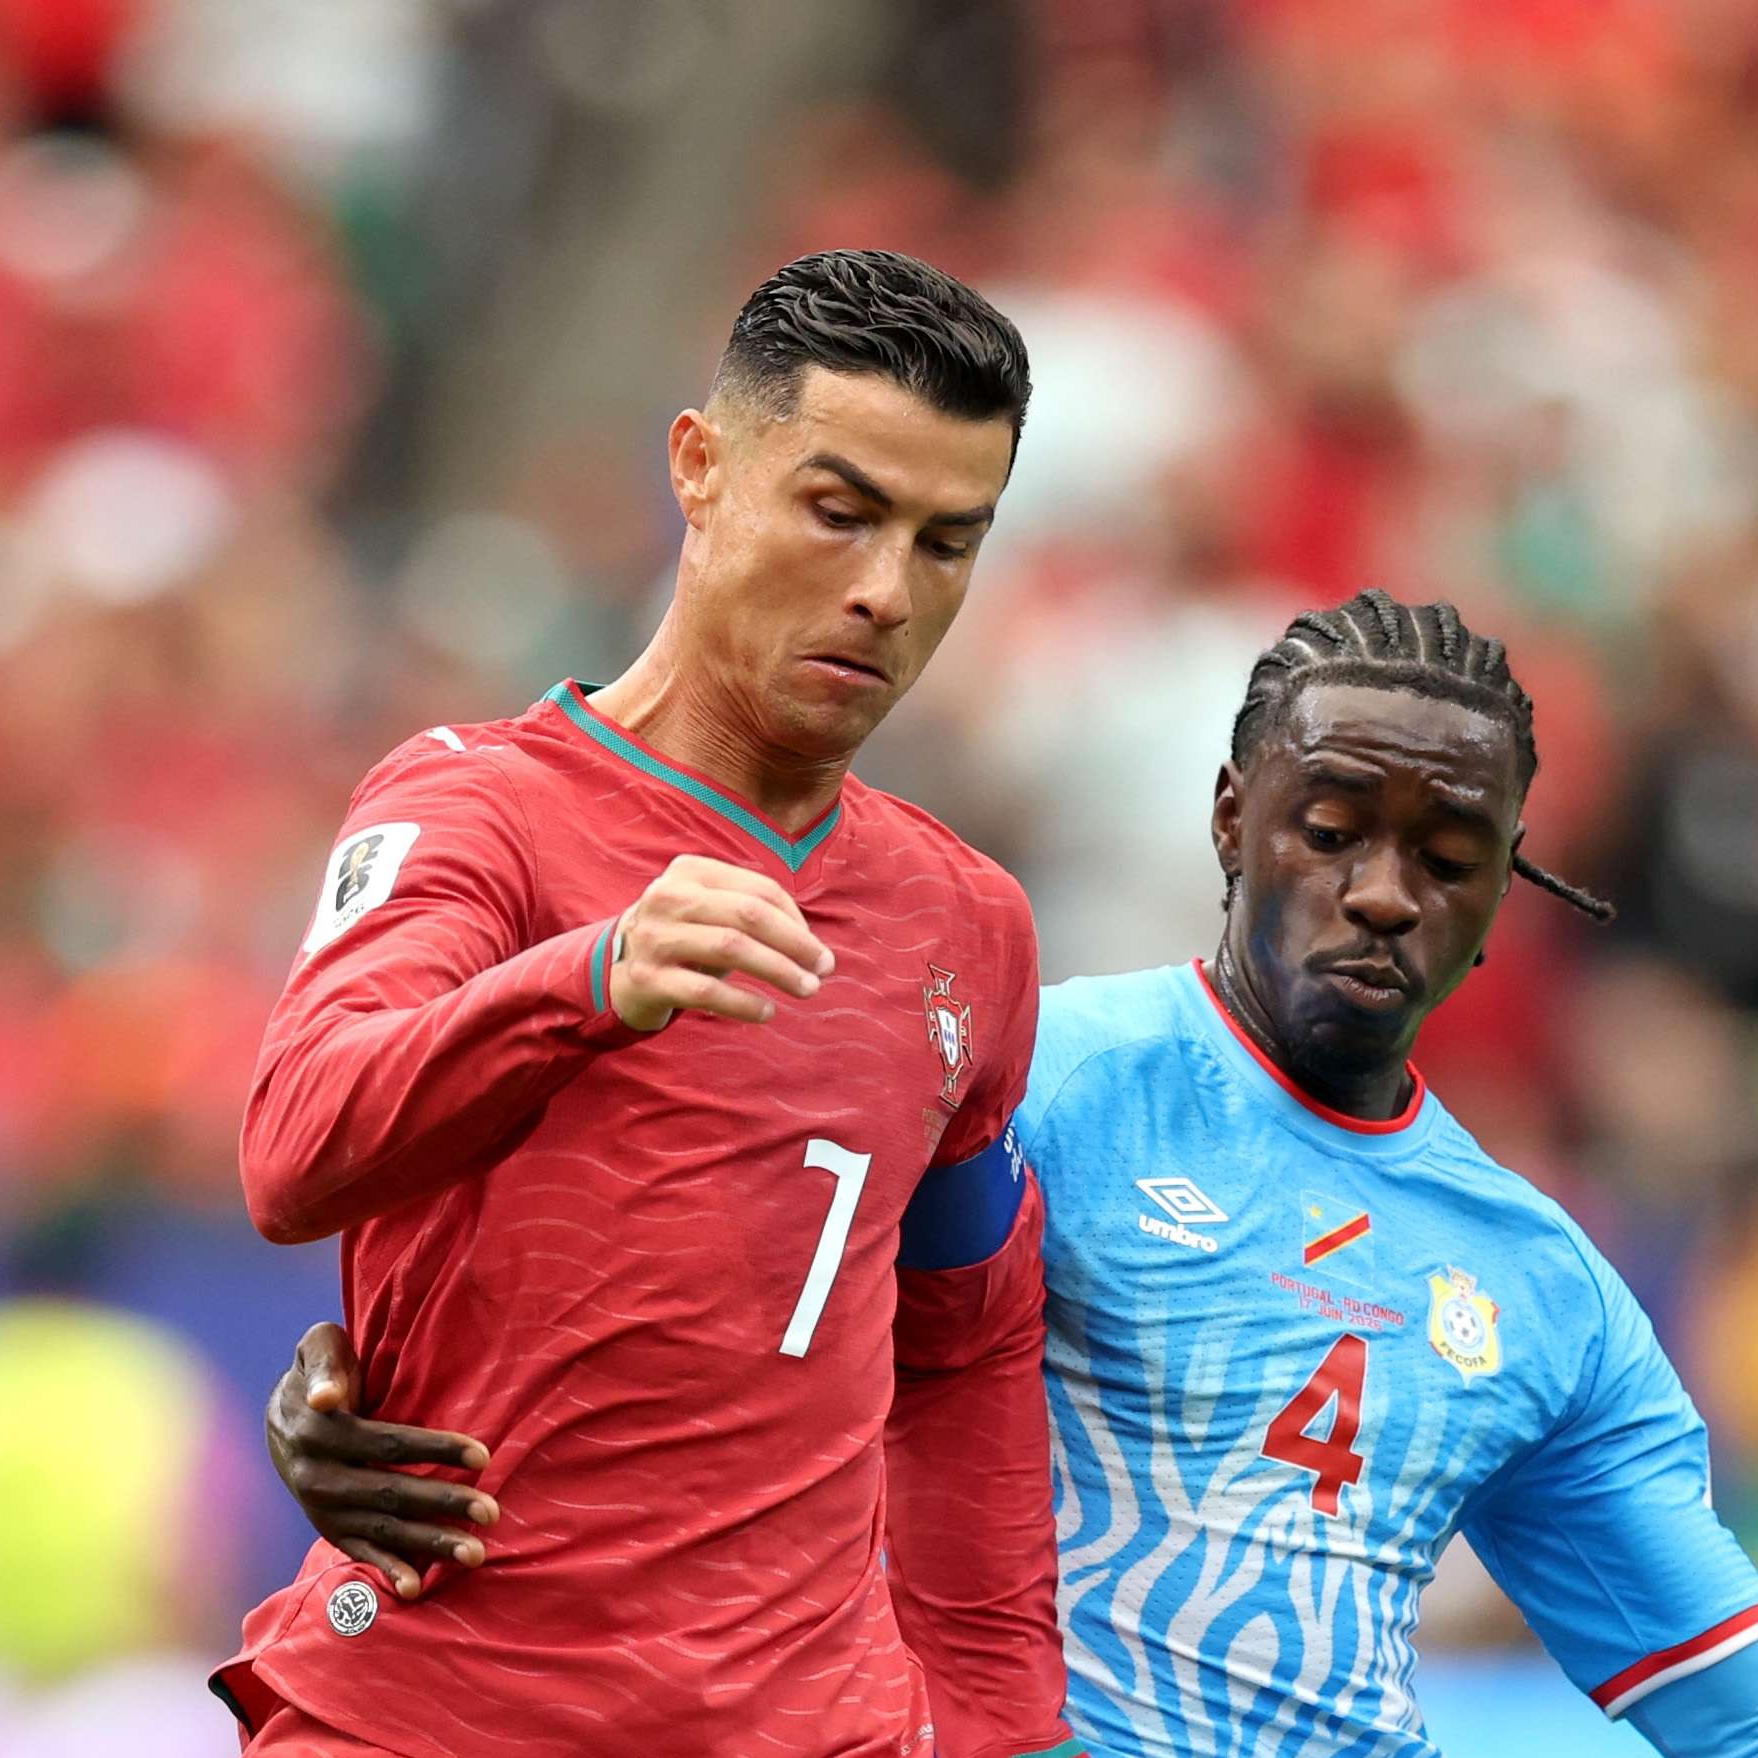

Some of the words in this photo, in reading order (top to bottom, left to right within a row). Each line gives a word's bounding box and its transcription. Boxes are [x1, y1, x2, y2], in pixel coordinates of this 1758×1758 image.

[779, 1138, 873, 1358] 7
[1138, 1215, 1218, 1254] umbro
[1271, 1271, 1334, 1305] PORTUGAL
[1363, 1303, 1404, 1326] CONGO
[1318, 1304, 1343, 1321] JUIN
[1260, 1333, 1369, 1518] 4
